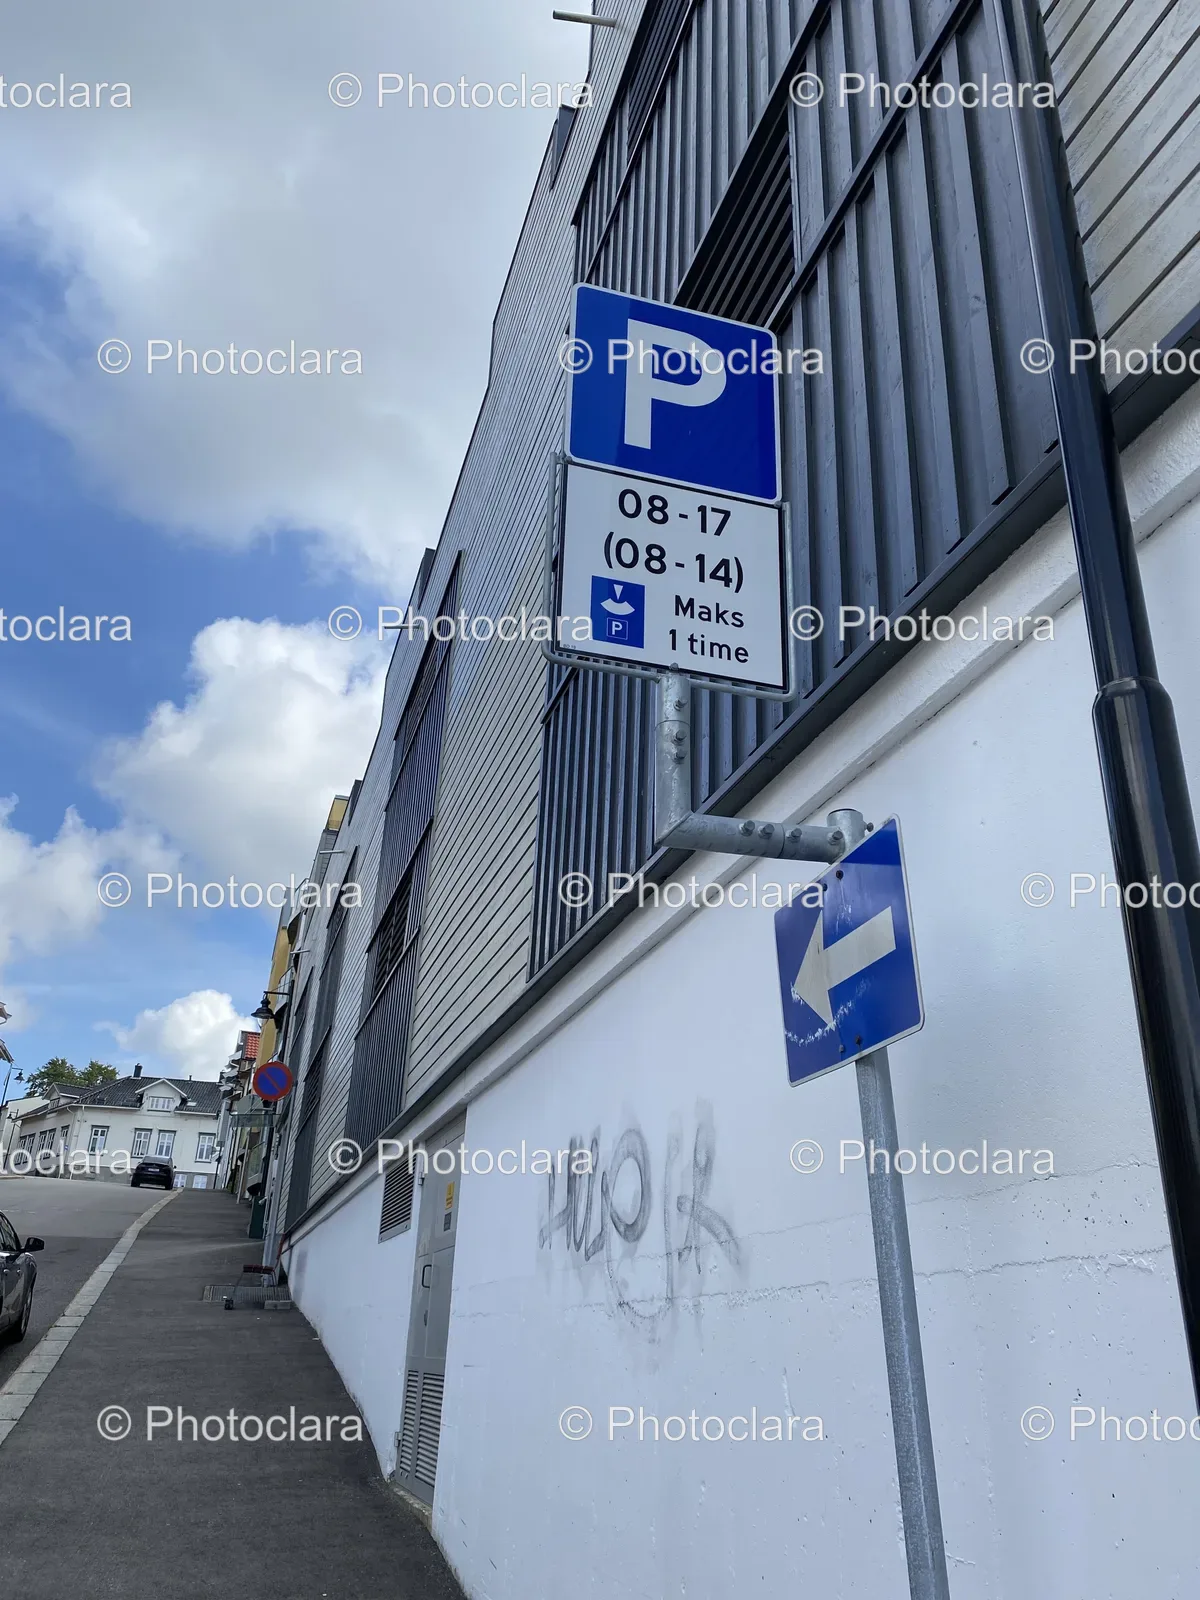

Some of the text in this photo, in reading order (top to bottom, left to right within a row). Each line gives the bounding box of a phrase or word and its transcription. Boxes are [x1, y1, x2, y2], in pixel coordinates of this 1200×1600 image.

[624, 318, 727, 450] P
[675, 594, 745, 628] Maks
[669, 628, 749, 663] 1 time
